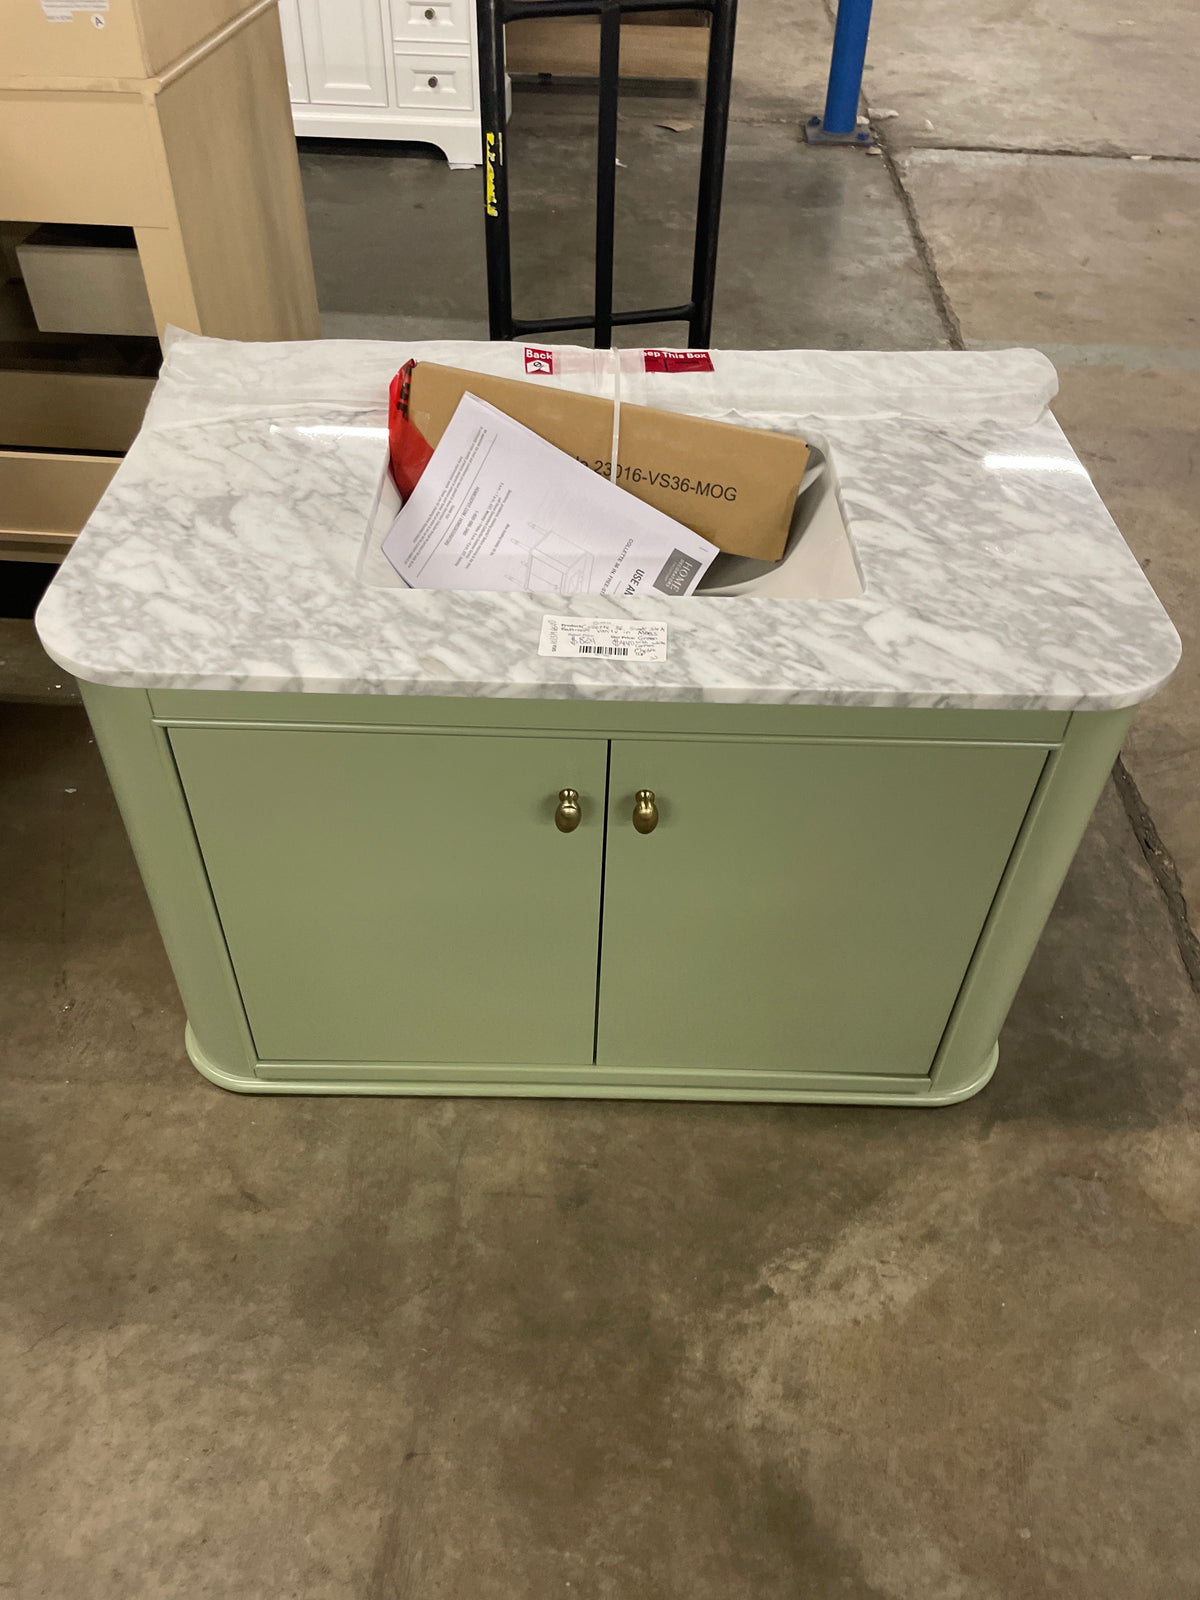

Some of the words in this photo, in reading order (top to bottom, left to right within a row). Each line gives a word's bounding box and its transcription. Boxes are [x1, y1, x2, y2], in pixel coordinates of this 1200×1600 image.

[525, 348, 552, 359] Back
[594, 460, 738, 501] 23016-VS36-MOG
[630, 568, 645, 586] USE
[670, 560, 693, 592] HOME
